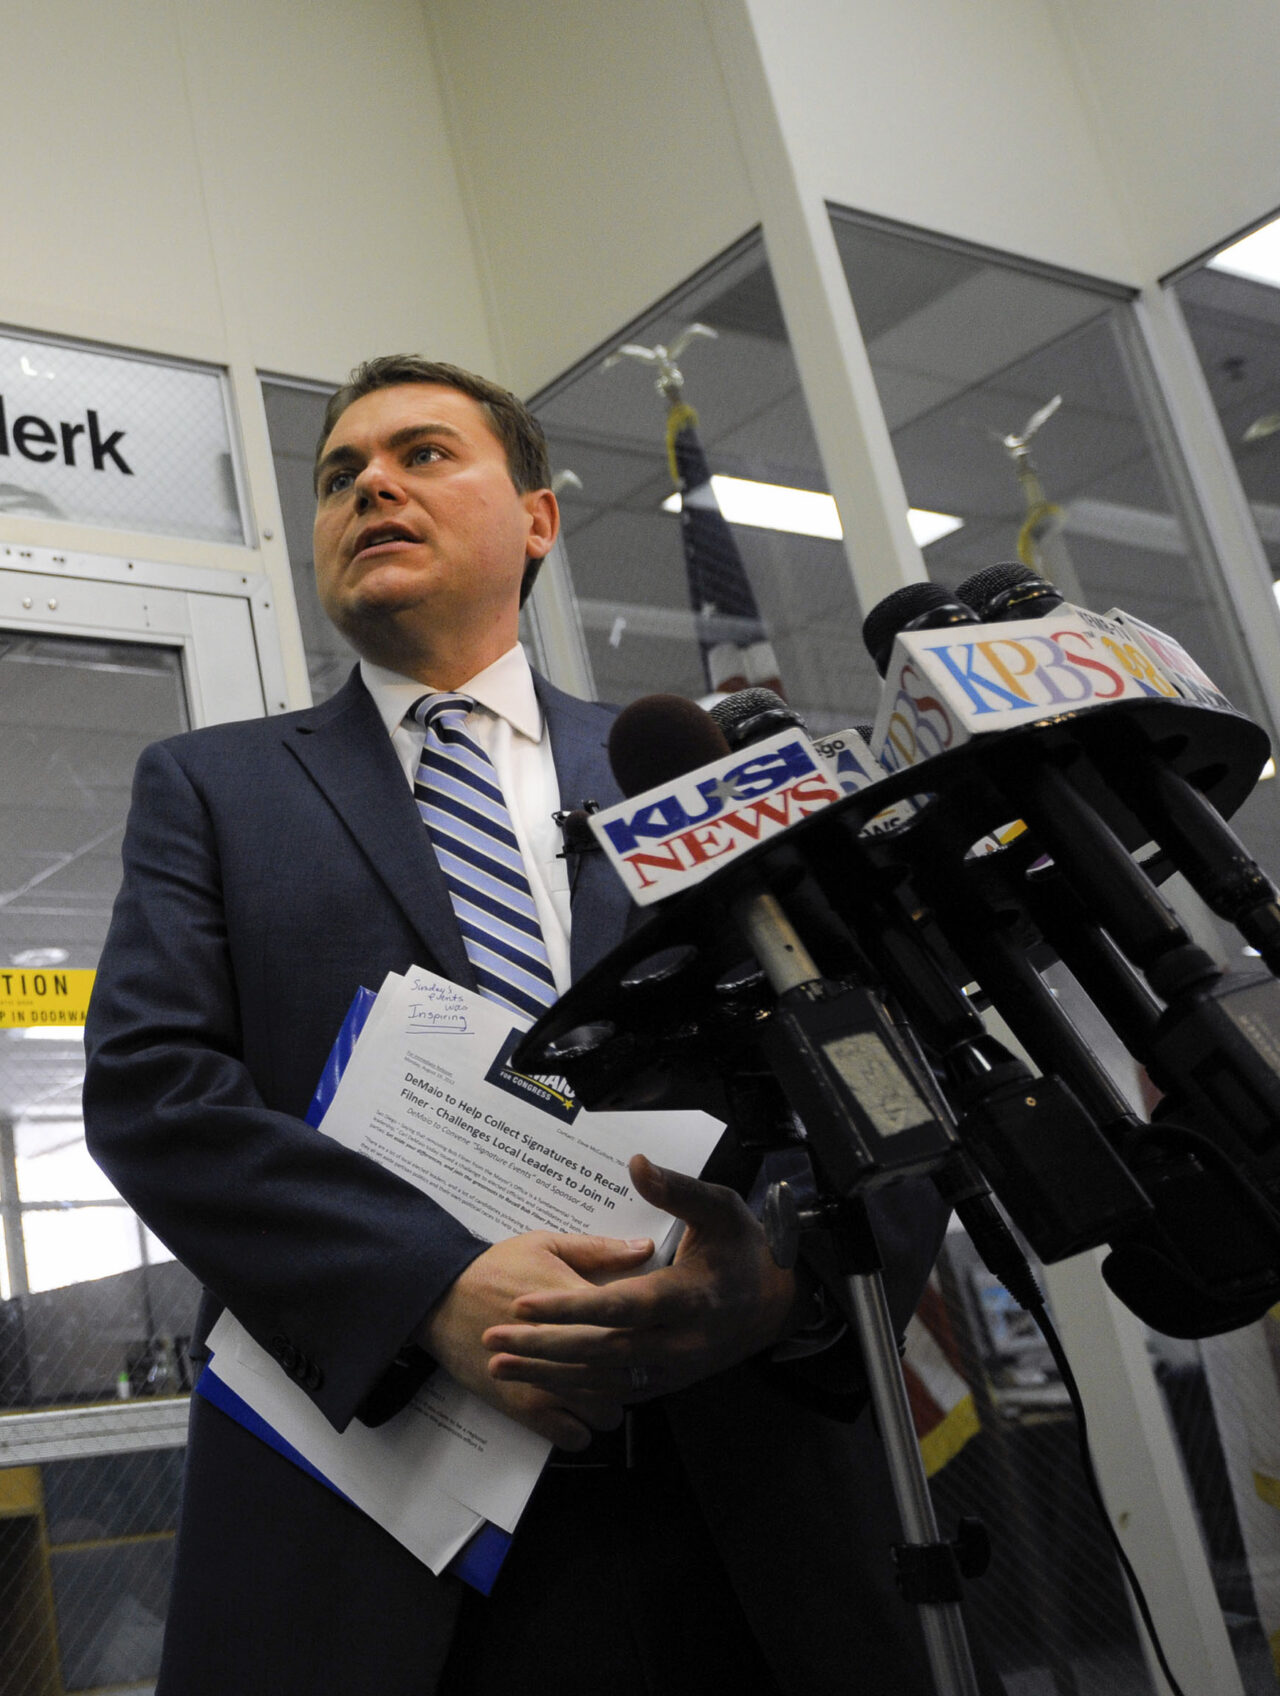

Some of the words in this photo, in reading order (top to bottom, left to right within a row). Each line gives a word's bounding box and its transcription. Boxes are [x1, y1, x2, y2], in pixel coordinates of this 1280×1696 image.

[923, 631, 1125, 716] KPBS
[602, 740, 822, 855] KUSI
[623, 773, 843, 888] NEWS
[12, 1011, 25, 1023] IN
[408, 1004, 467, 1031] Inspiring
[511, 1075, 552, 1101] CONGRESS
[400, 1087, 429, 1109] Filner
[433, 1105, 492, 1144] Challenges
[491, 1136, 521, 1158] Local
[520, 1152, 565, 1182] Leaders
[564, 1177, 578, 1189] to
[578, 1183, 603, 1202] Join
[603, 1196, 617, 1210] In
[403, 1071, 445, 1099] DeMaio
[443, 1093, 457, 1105] to
[456, 1099, 483, 1121] Help
[482, 1113, 521, 1139] Collect
[519, 1133, 579, 1172] Signatures
[578, 1165, 593, 1178] to
[593, 1172, 629, 1197] Recall
[535, 1176, 551, 1188] and
[550, 1184, 581, 1206] Sponsor
[580, 1200, 595, 1212] Ads
